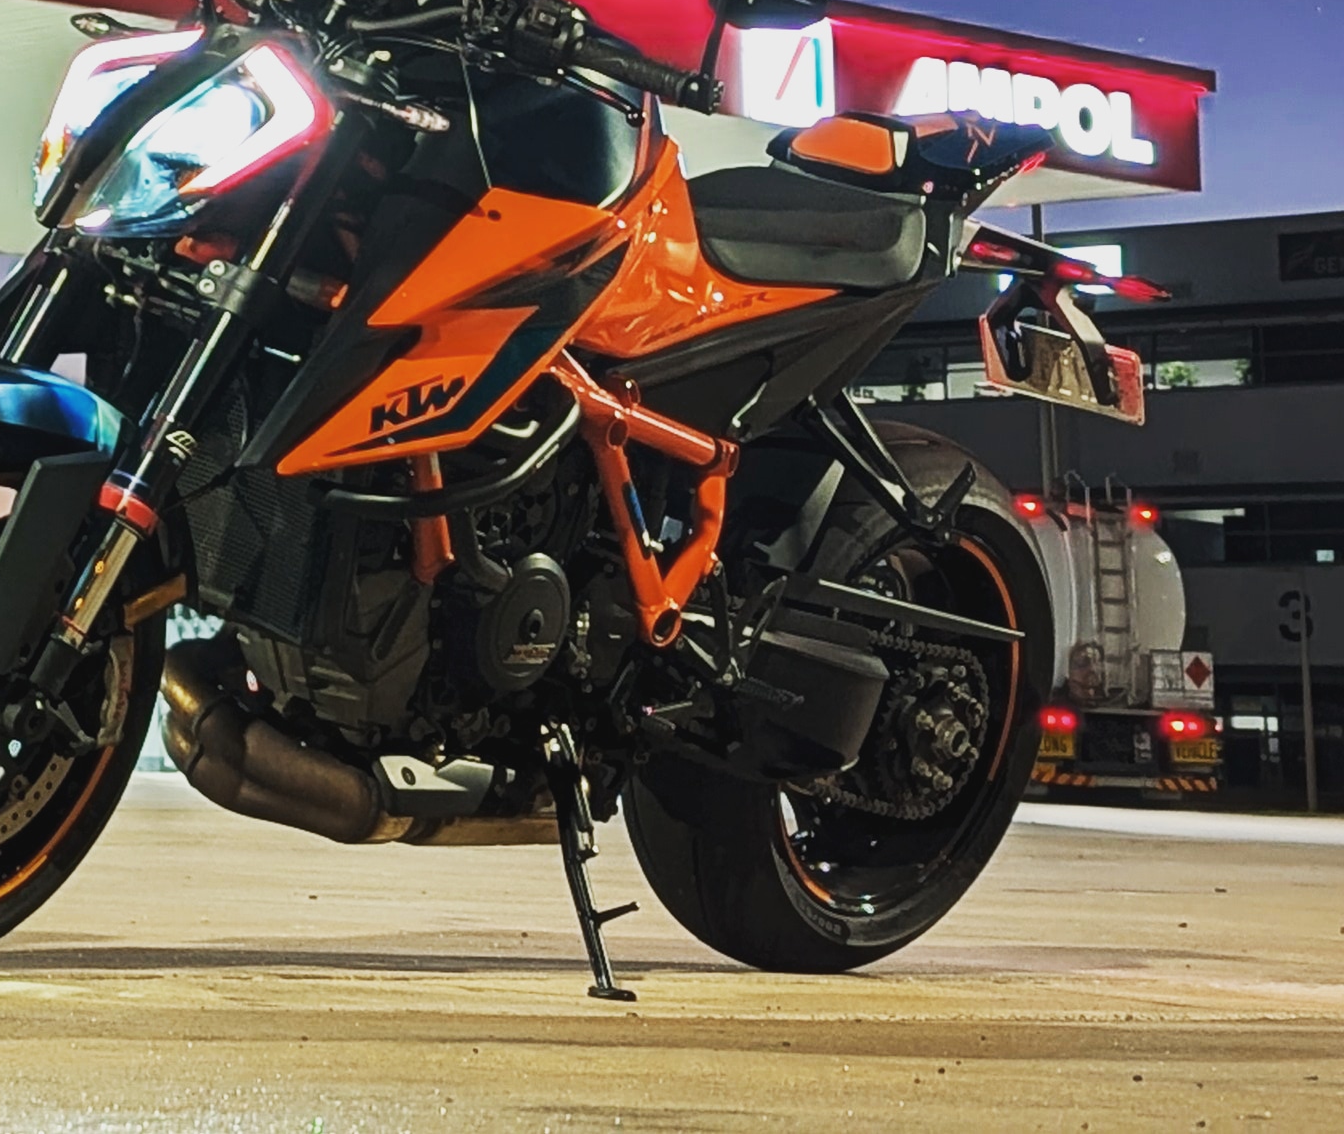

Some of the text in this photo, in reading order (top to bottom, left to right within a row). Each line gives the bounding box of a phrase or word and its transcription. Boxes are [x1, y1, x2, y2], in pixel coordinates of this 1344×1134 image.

[892, 56, 1156, 165] AMPOL
[369, 374, 466, 434] KTM
[1279, 590, 1313, 642] 3
